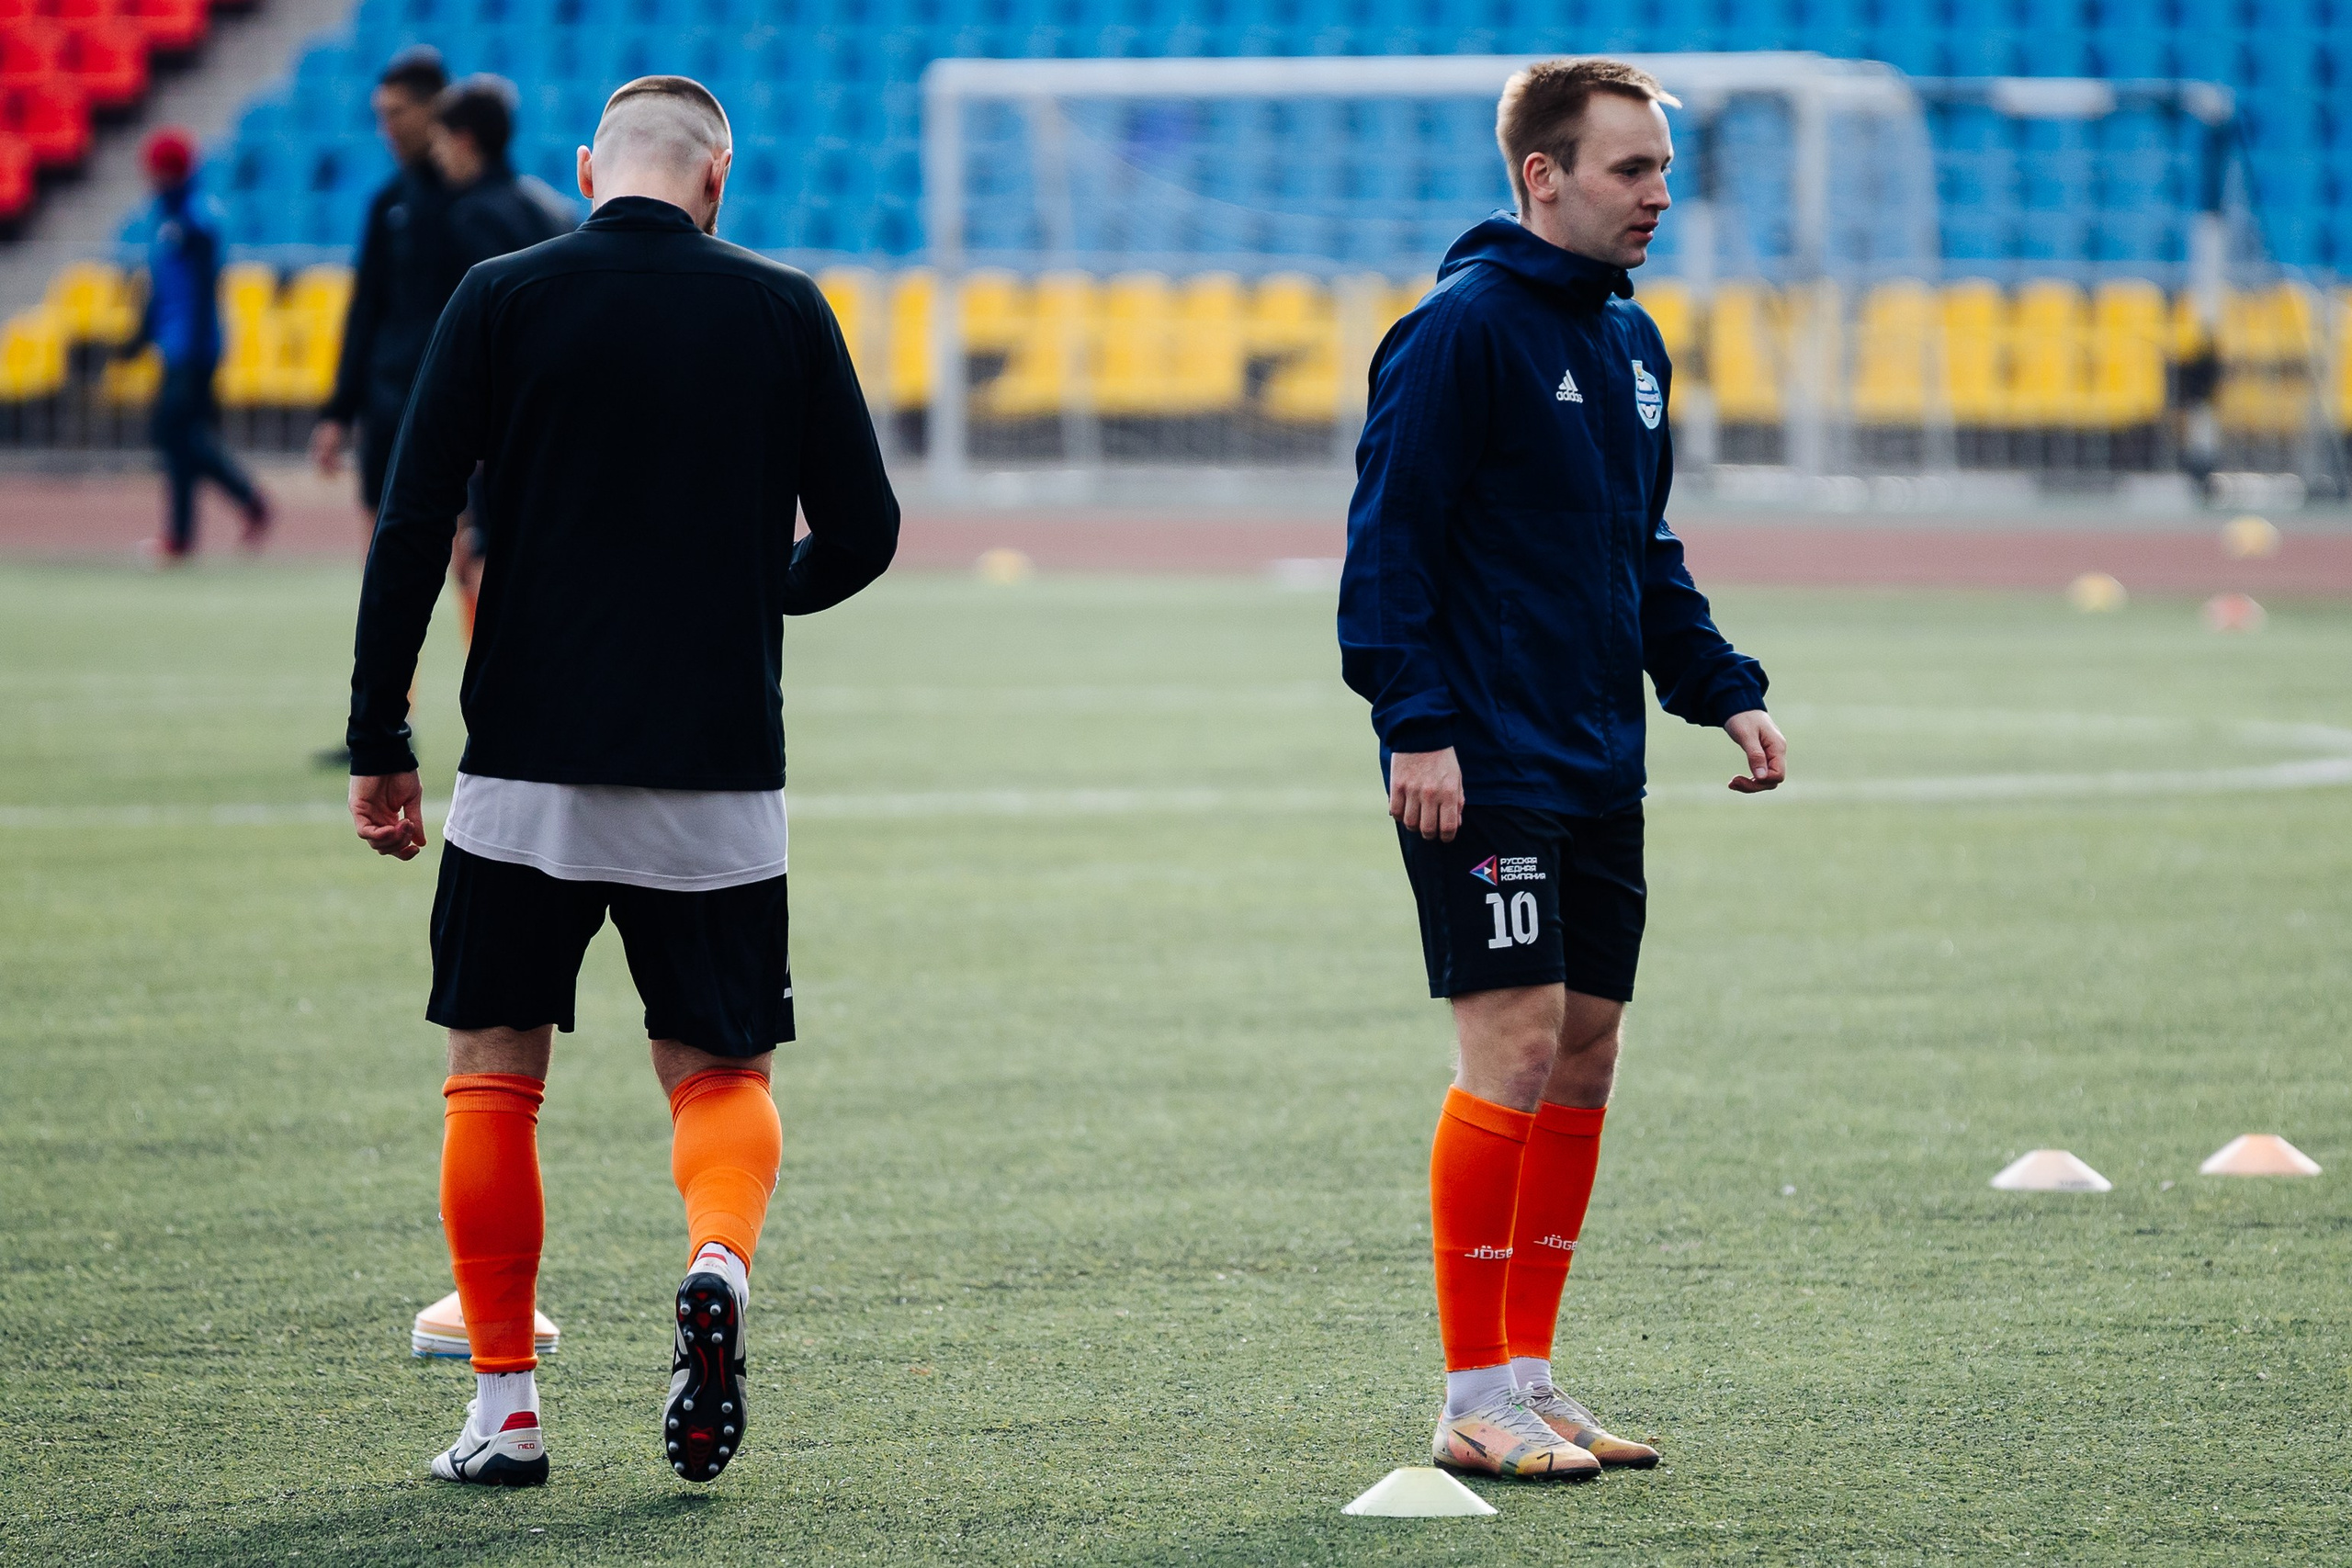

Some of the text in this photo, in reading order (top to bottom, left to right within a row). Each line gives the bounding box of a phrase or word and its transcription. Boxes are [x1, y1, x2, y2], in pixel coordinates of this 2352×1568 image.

[1555, 390, 1583, 403] adidas
[1499, 857, 1538, 865] РУССКАЯ
[1500, 864, 1537, 874] МЕДНАЯ
[1500, 873, 1546, 881] КОМПАНИЯ
[1486, 891, 1539, 949] 10
[1464, 1245, 1514, 1259] JÖGE
